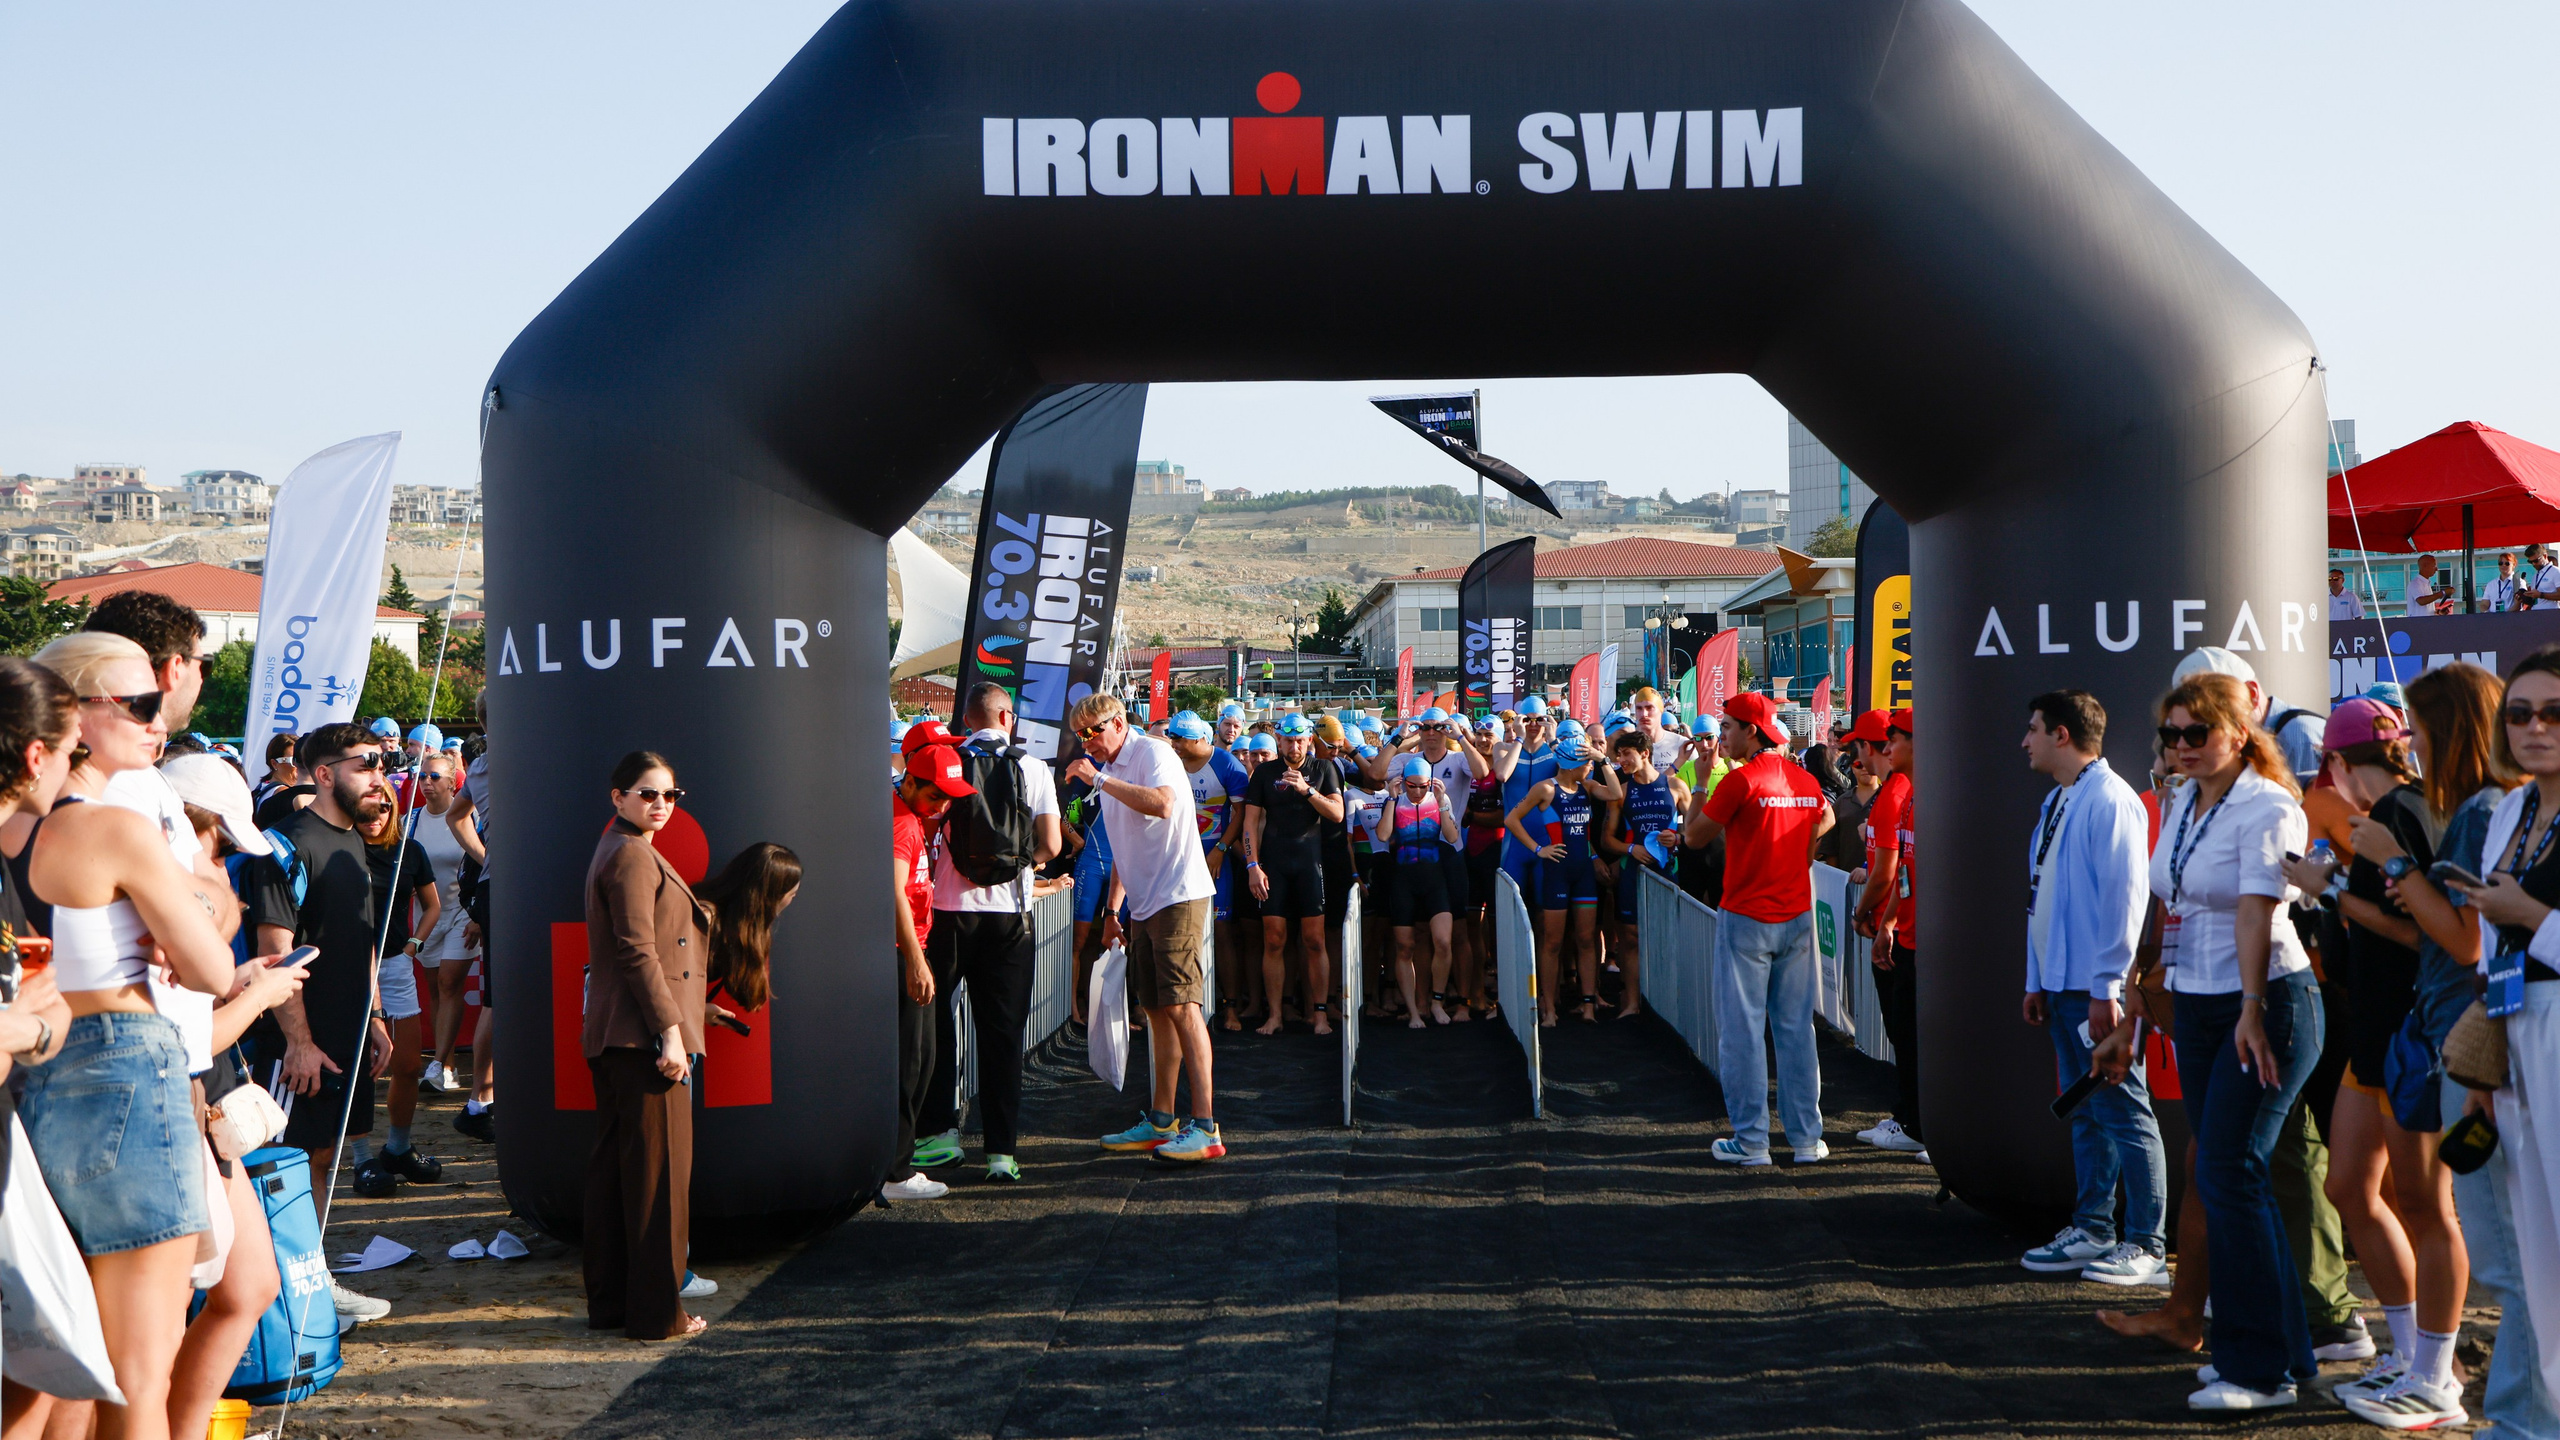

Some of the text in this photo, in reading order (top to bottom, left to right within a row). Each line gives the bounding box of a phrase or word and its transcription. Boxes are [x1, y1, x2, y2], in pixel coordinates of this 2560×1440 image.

[1516, 106, 1804, 195] SWIM
[1419, 407, 1472, 423] IRONMAN
[262, 655, 277, 718] SINCE 1947
[1579, 677, 1589, 712] circuit
[1711, 664, 1725, 707] circuit
[1632, 800, 1665, 808] ALUFAR
[1758, 796, 1818, 808] VOLUNTEER
[1569, 825, 1585, 836] AZE
[2488, 966, 2523, 984] MEDIA
